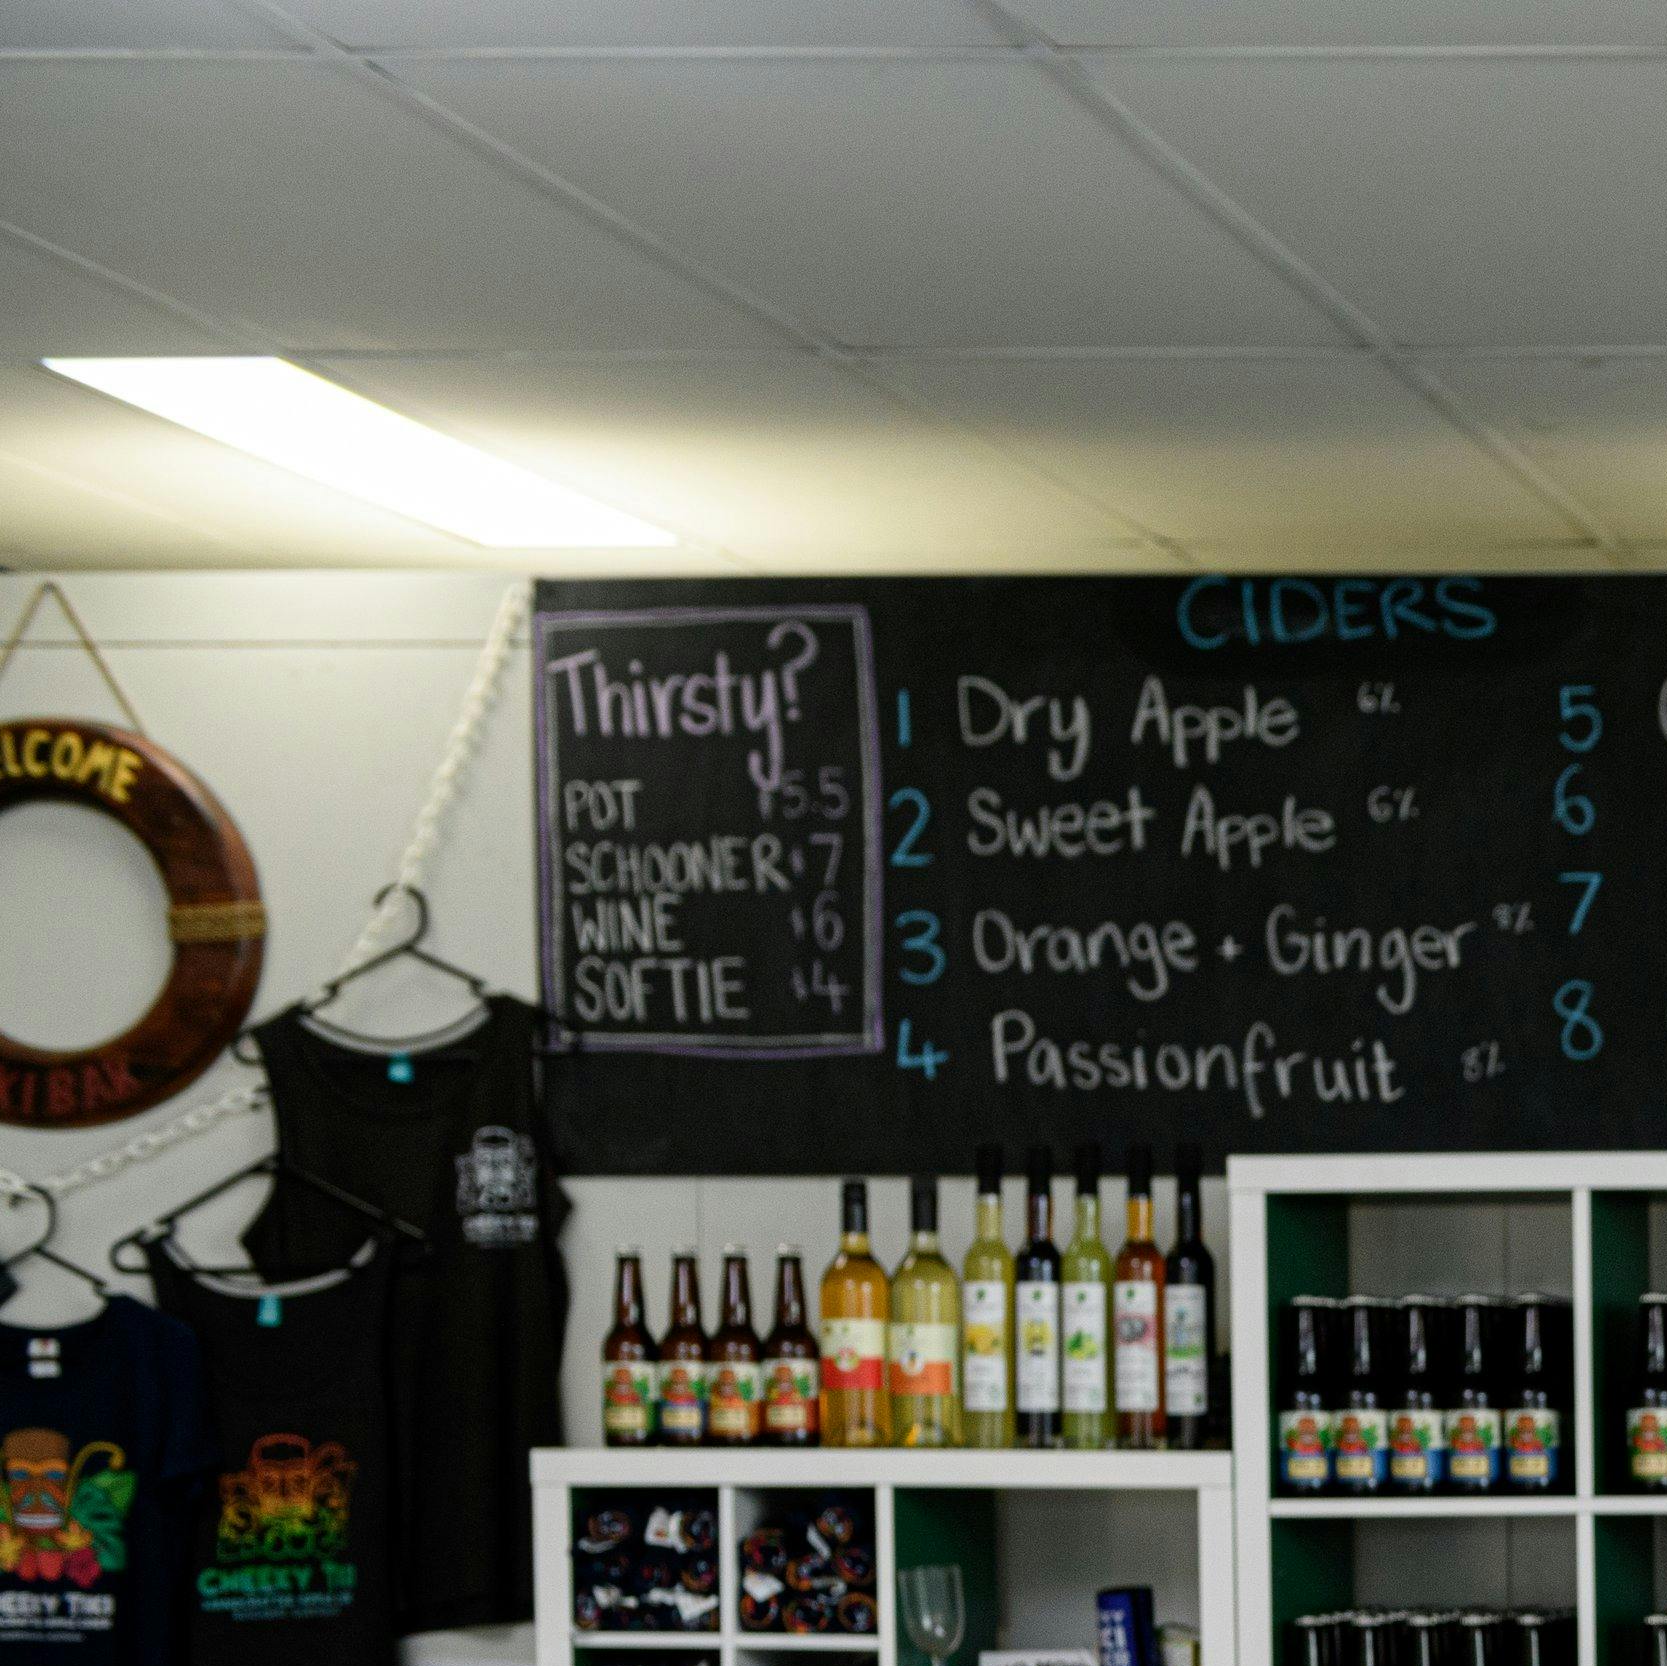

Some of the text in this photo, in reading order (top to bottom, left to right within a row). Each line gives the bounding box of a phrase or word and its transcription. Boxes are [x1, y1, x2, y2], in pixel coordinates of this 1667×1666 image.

[1177, 575, 1496, 649] CIDERS
[547, 621, 820, 792] Thirsty?
[958, 676, 1090, 781] Dry
[1130, 676, 1299, 767] Apple
[1558, 685, 1601, 752] 5
[0, 727, 143, 804] LCOME
[1553, 763, 1596, 834] 6
[566, 779, 642, 831] POT
[890, 788, 932, 867] 2
[968, 787, 1157, 856] Sweet
[1181, 785, 1336, 870] Apple
[566, 833, 791, 894] SCHOONER
[571, 895, 684, 952] WINE
[1558, 872, 1604, 934] 7
[574, 956, 750, 1024] SOFTIE
[897, 910, 947, 984] 3
[973, 909, 1197, 1001] Orange
[1266, 903, 1477, 1015] Ginger
[1553, 979, 1602, 1060] 8
[897, 1018, 950, 1079] 4
[991, 1009, 1403, 1119] Passionfruit
